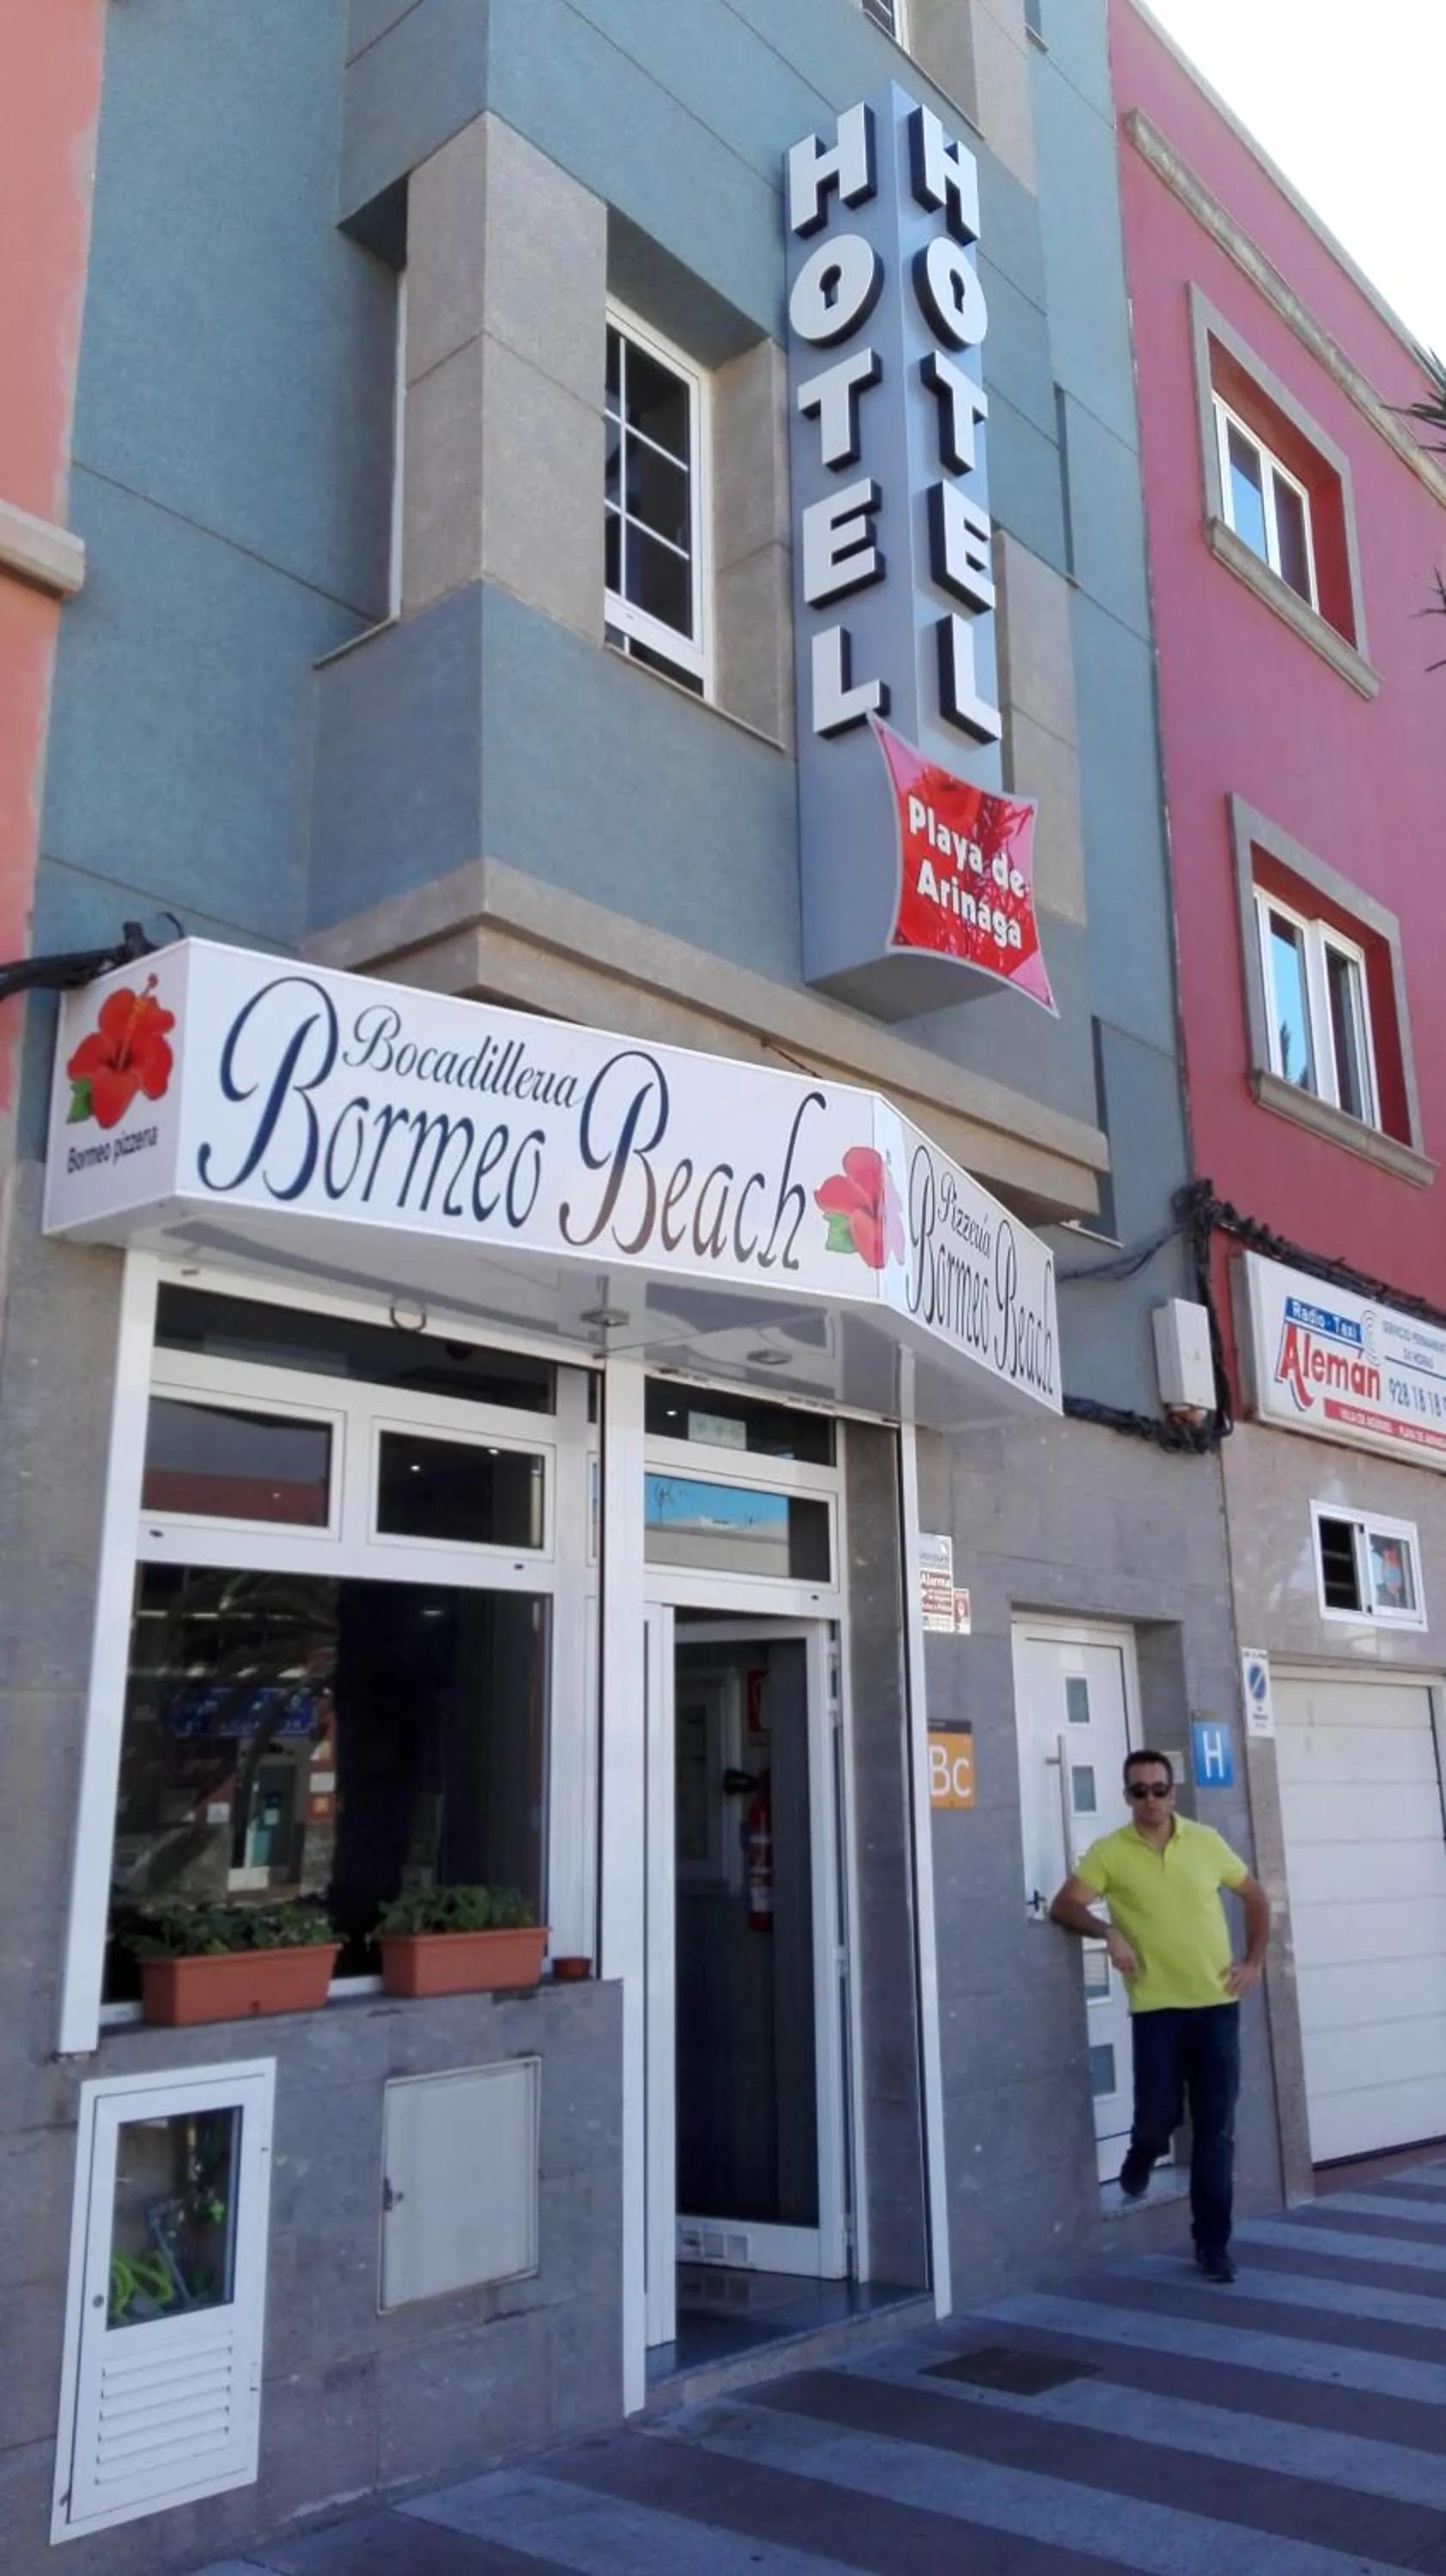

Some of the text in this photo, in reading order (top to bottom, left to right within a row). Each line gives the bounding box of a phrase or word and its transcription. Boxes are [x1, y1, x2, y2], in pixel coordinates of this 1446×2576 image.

[788, 100, 891, 739] HOTEL
[908, 102, 1002, 745] HOTEL
[908, 794, 1025, 897] Playa de
[916, 859, 1023, 949] Arinaga
[197, 976, 827, 1271] Bormeo Beach
[906, 1145, 1054, 1395] Bormeo Beach
[1291, 1300, 1326, 1328] Radio
[1333, 1315, 1358, 1340] Taxi
[929, 1744, 971, 1799] Bc
[1203, 1730, 1224, 1778] H
